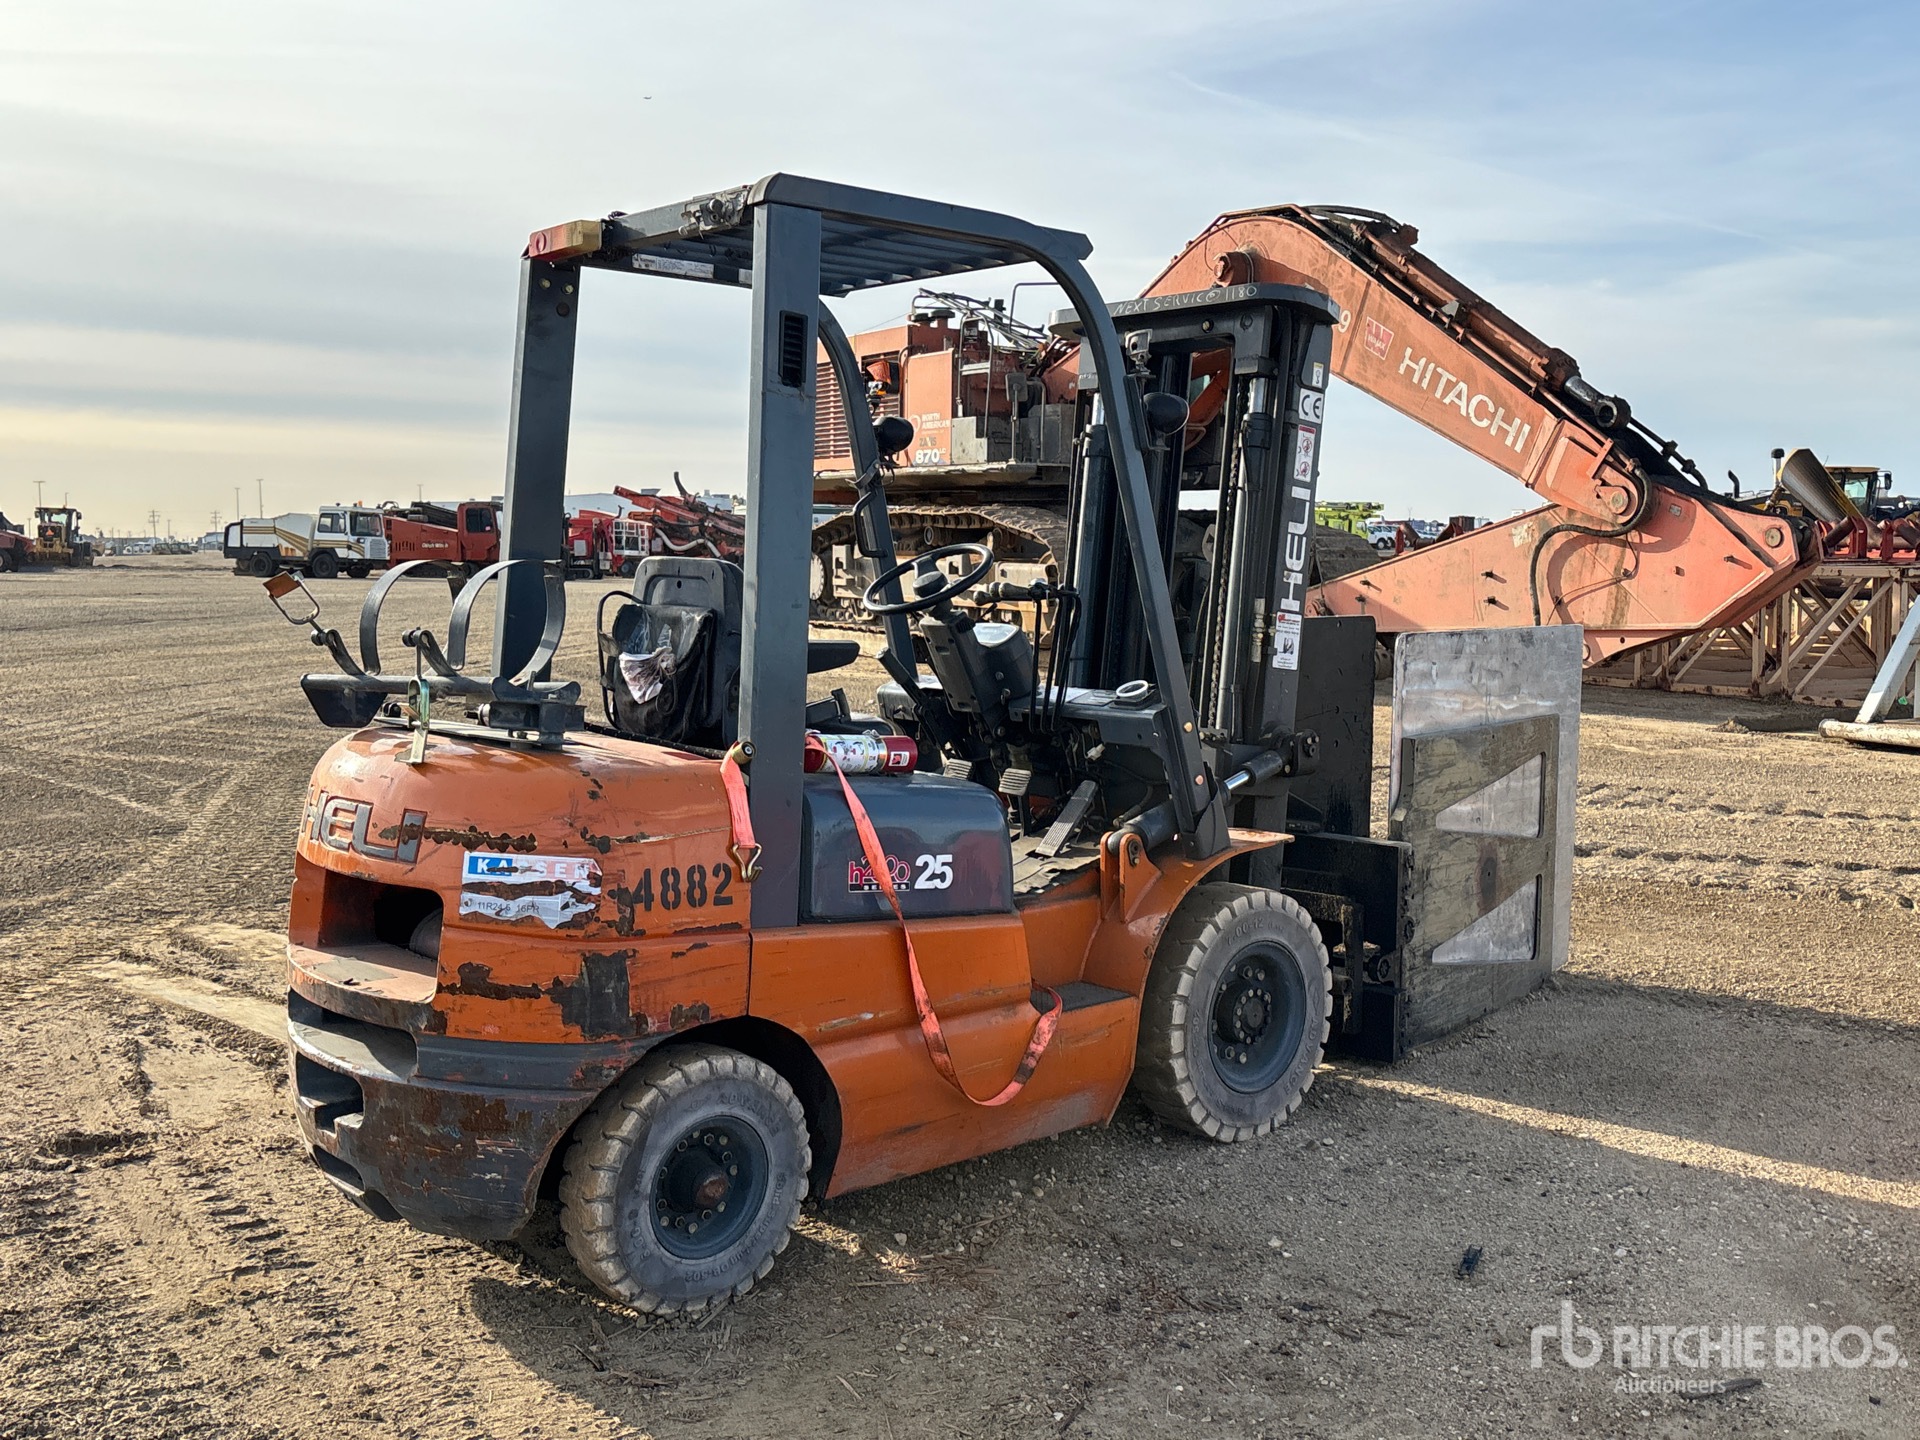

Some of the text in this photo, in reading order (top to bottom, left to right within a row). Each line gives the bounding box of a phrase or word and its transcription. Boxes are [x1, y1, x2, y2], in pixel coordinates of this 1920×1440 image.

[1114, 298, 1149, 315] NEXT
[1302, 394, 1322, 420] CE
[1397, 346, 1532, 454] HITACHI
[1281, 486, 1311, 611] HELI
[302, 786, 427, 864] HELI
[632, 862, 733, 912] 4882
[863, 883, 907, 891] SEES
[914, 854, 954, 889] 25
